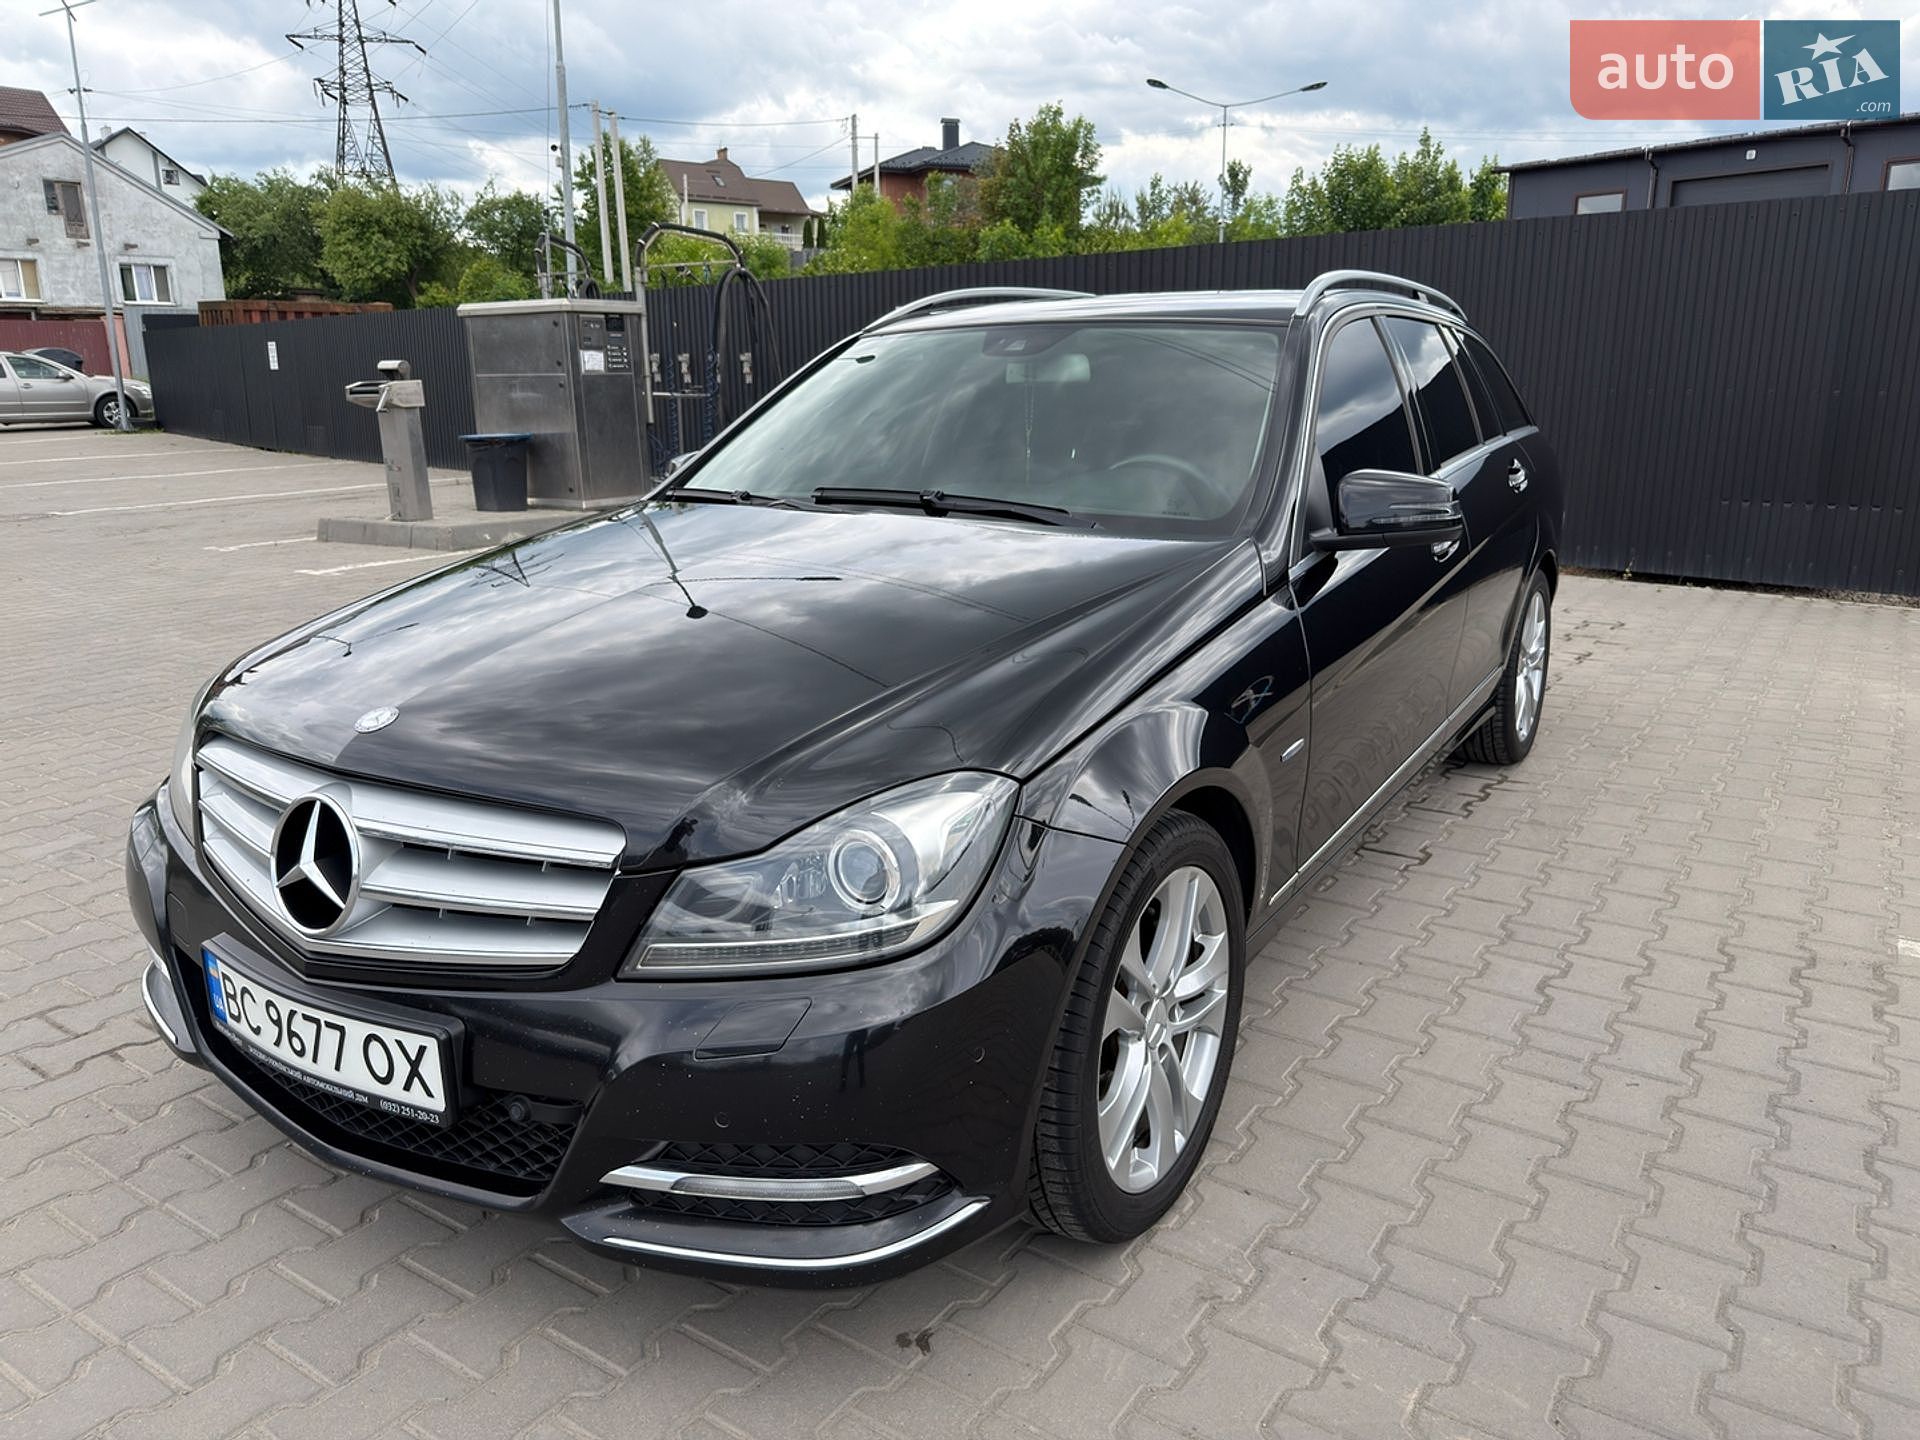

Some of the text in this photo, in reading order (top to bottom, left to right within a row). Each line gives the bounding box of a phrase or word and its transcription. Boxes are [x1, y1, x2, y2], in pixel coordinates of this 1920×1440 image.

[221, 971, 261, 1036] BC
[265, 999, 346, 1072] 9677
[362, 1033, 435, 1098] OX
